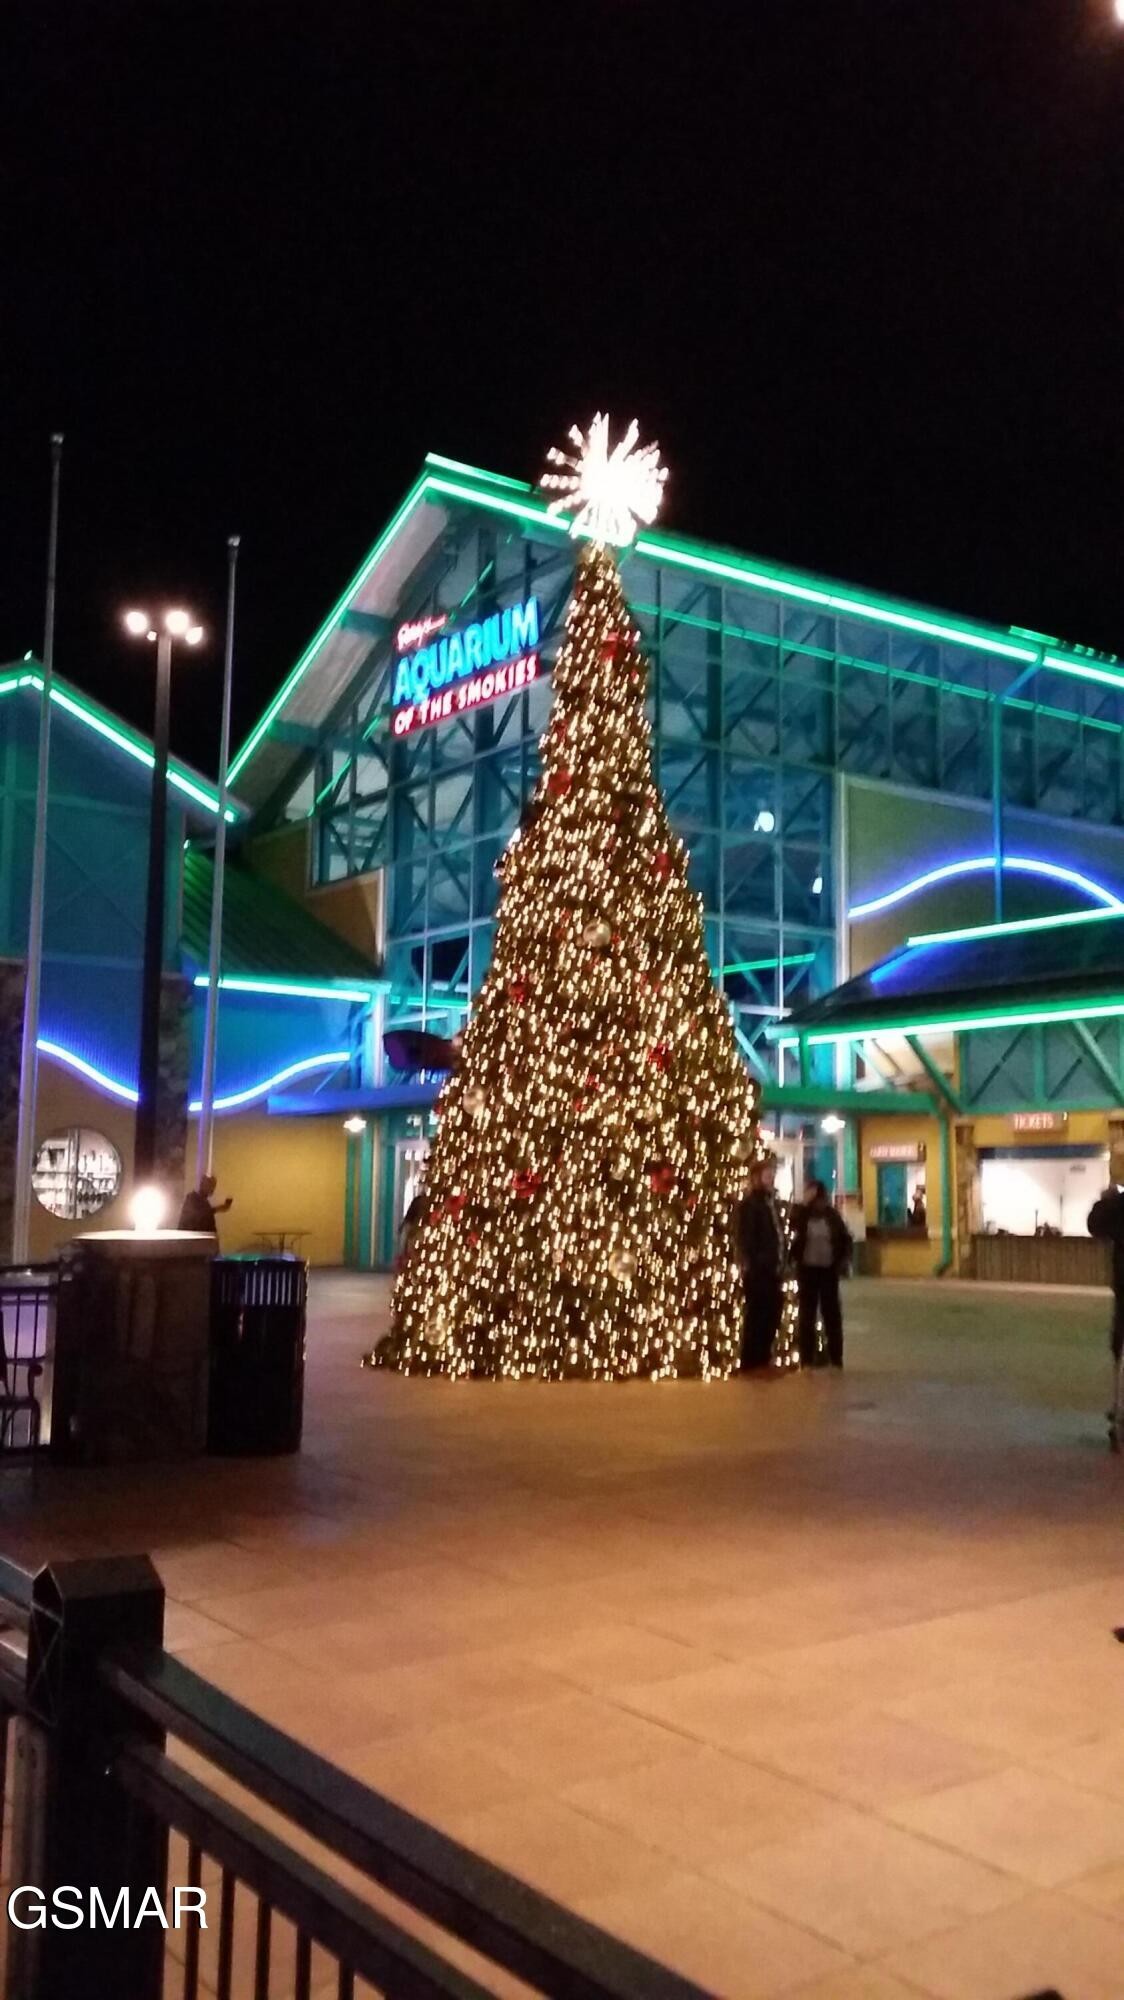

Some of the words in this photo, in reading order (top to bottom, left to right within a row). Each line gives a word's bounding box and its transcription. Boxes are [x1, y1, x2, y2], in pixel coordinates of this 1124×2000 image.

[392, 596, 538, 706] AQUARIUM
[394, 706, 415, 735] OF
[418, 692, 454, 725] THE
[457, 654, 538, 709] SMOKIES
